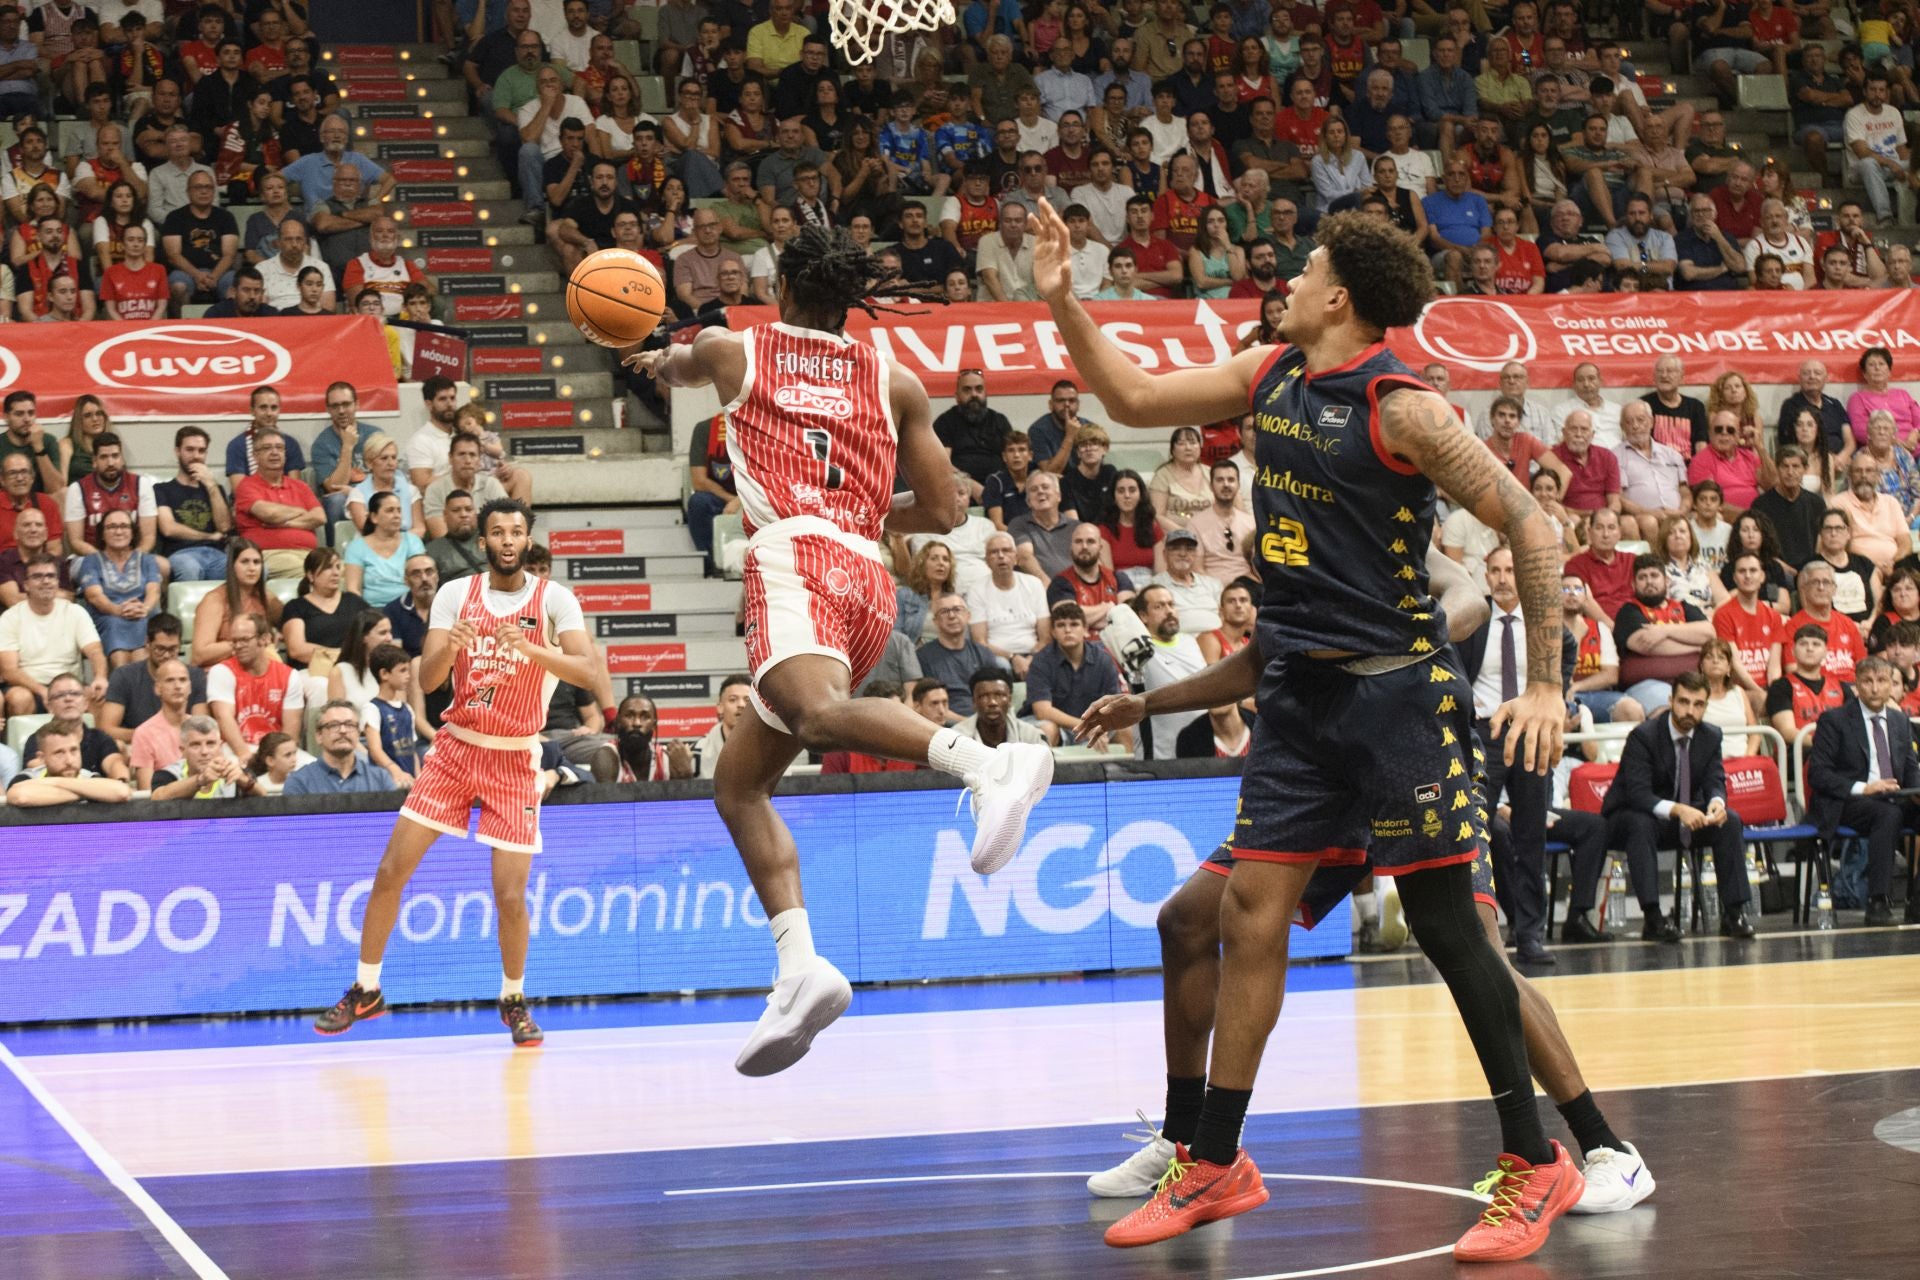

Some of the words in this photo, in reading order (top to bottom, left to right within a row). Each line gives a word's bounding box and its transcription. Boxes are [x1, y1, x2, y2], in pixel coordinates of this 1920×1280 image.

[117, 299, 157, 313] UCAM
[1553, 316, 1604, 330] Costa
[1611, 315, 1667, 328] Cálida
[1560, 332, 1706, 357] REGIÓN
[1713, 331, 1768, 351] DE
[1770, 327, 1920, 351] MURCIA
[111, 351, 267, 377] Juver
[420, 349, 459, 366] MÓDULO
[775, 352, 856, 382] FORREST
[1258, 465, 1335, 503] Andorra
[1261, 516, 1310, 567] 22
[471, 659, 516, 675] MURCIA
[1730, 770, 1763, 784] UCAM
[1418, 791, 1436, 800] acb
[1375, 828, 1413, 837] telecom
